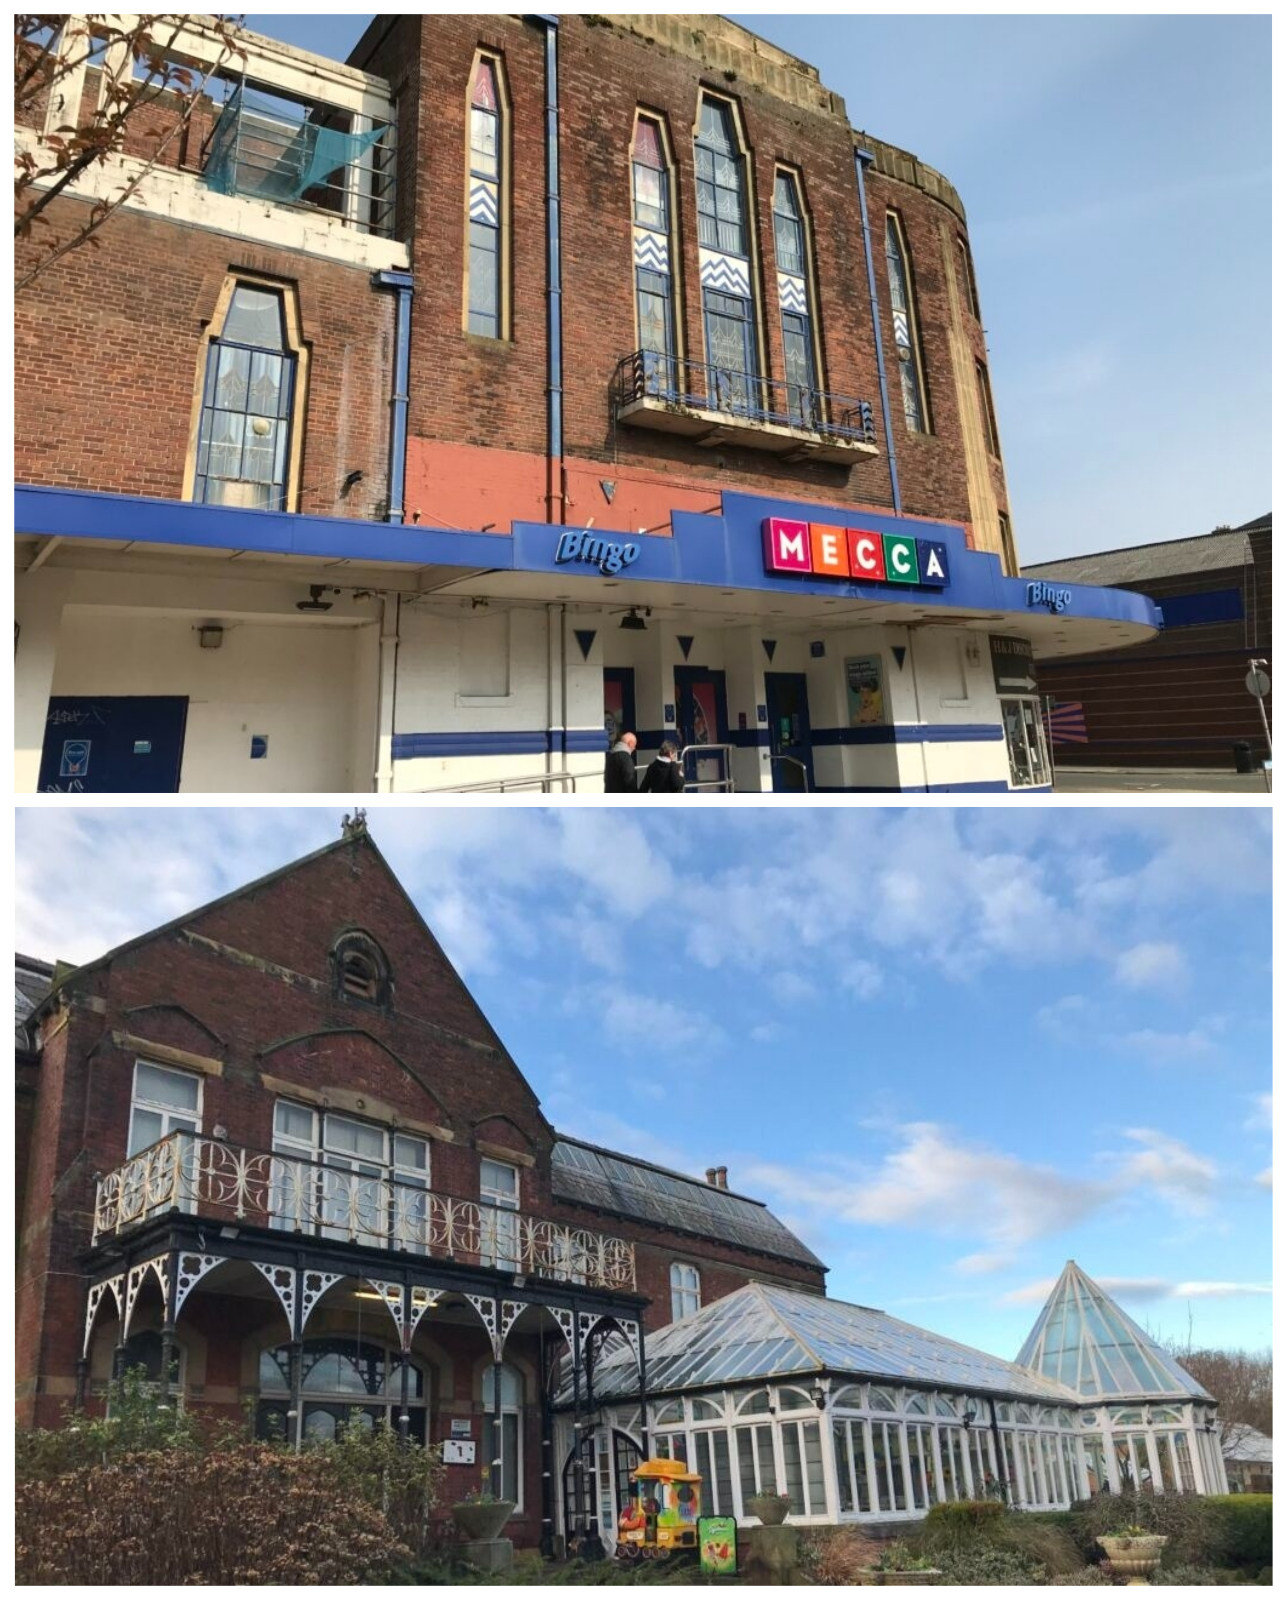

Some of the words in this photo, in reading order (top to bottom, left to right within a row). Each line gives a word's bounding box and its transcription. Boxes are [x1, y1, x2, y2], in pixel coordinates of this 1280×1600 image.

[555, 530, 641, 575] Bingo
[779, 529, 944, 578] MECCA
[1026, 582, 1072, 614] Bingo
